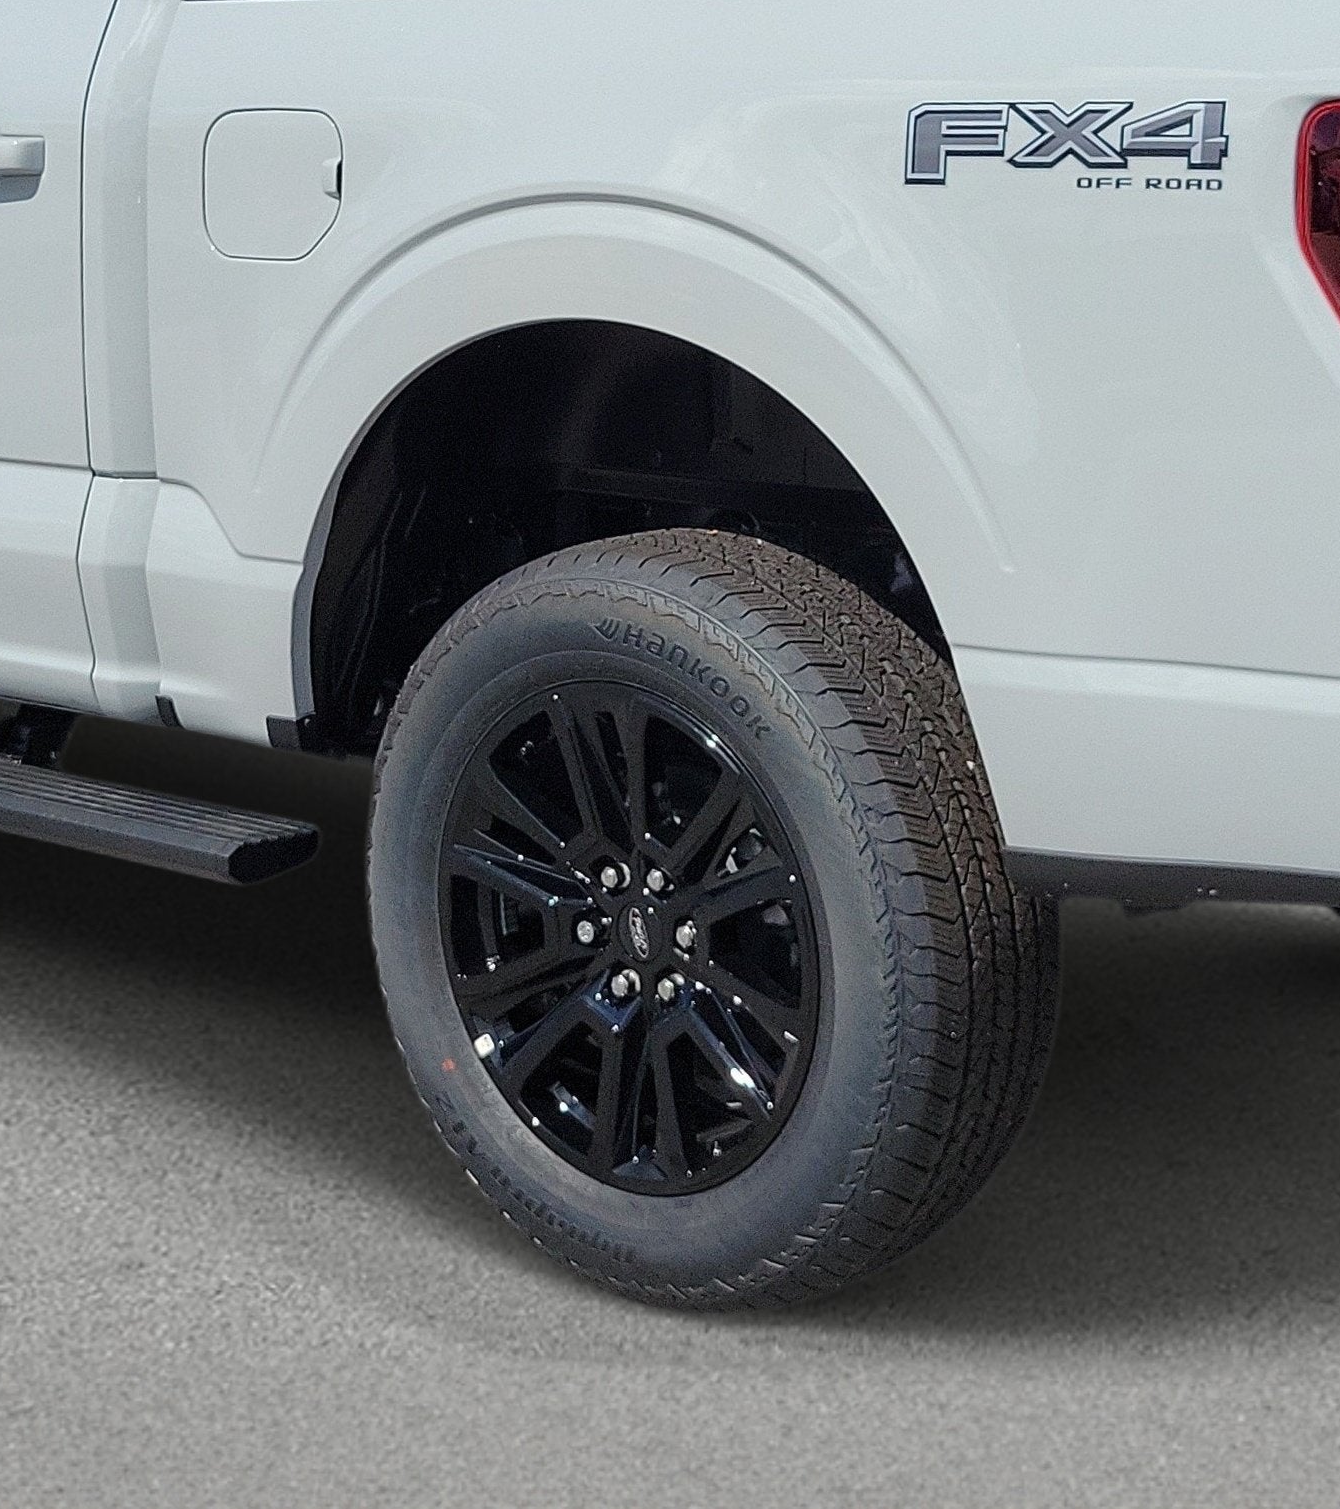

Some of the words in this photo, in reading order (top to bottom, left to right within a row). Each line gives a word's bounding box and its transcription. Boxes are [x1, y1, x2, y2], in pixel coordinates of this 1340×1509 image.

[904, 101, 1228, 185] FX4
[1076, 176, 1133, 190] OFF
[1144, 177, 1223, 191] ROAD
